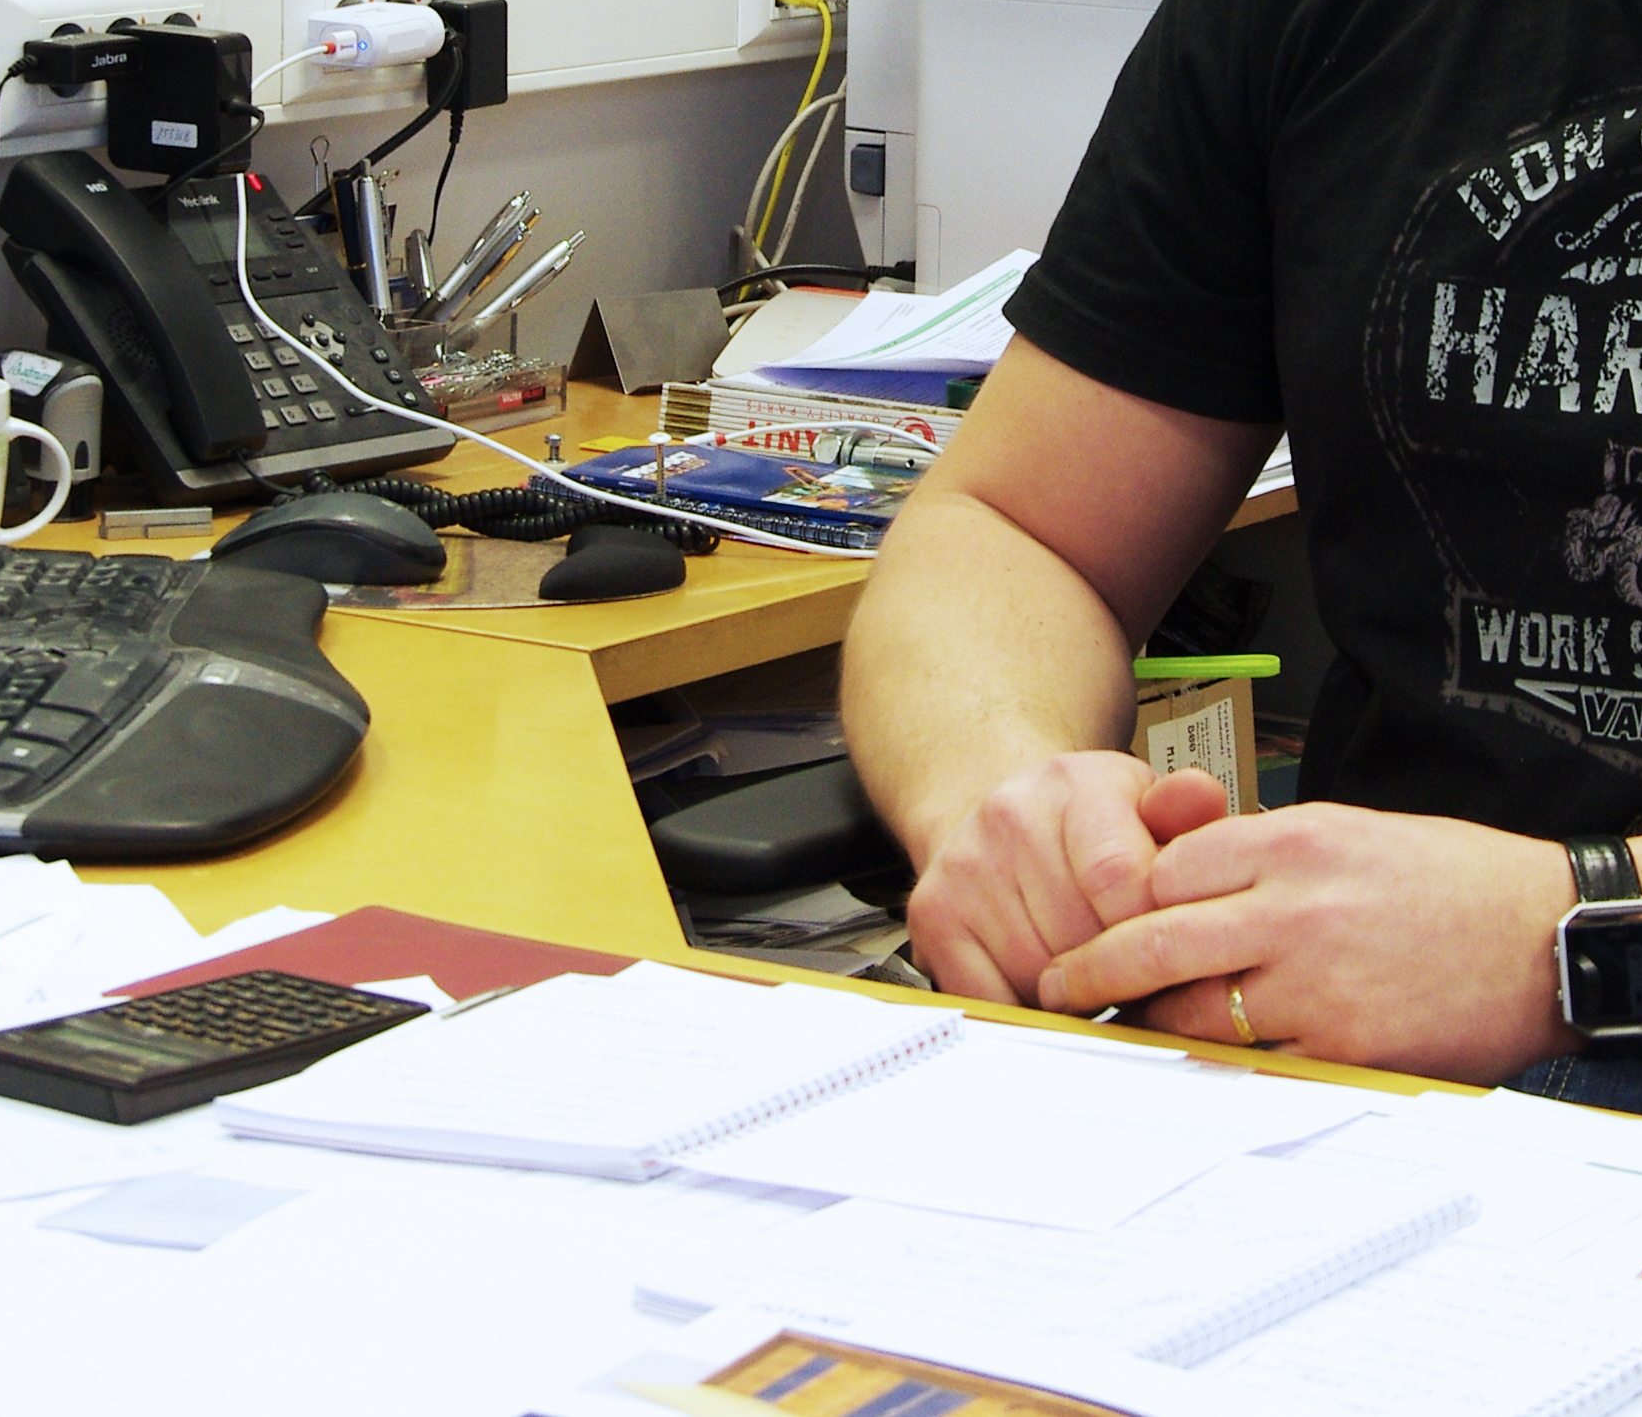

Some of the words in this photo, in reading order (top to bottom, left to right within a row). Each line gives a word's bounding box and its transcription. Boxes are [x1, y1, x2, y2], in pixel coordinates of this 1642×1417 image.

[91, 53, 127, 68] Jabra
[86, 182, 107, 193] HD
[746, 400, 797, 415] PARTS
[1475, 605, 1611, 676] WORK
